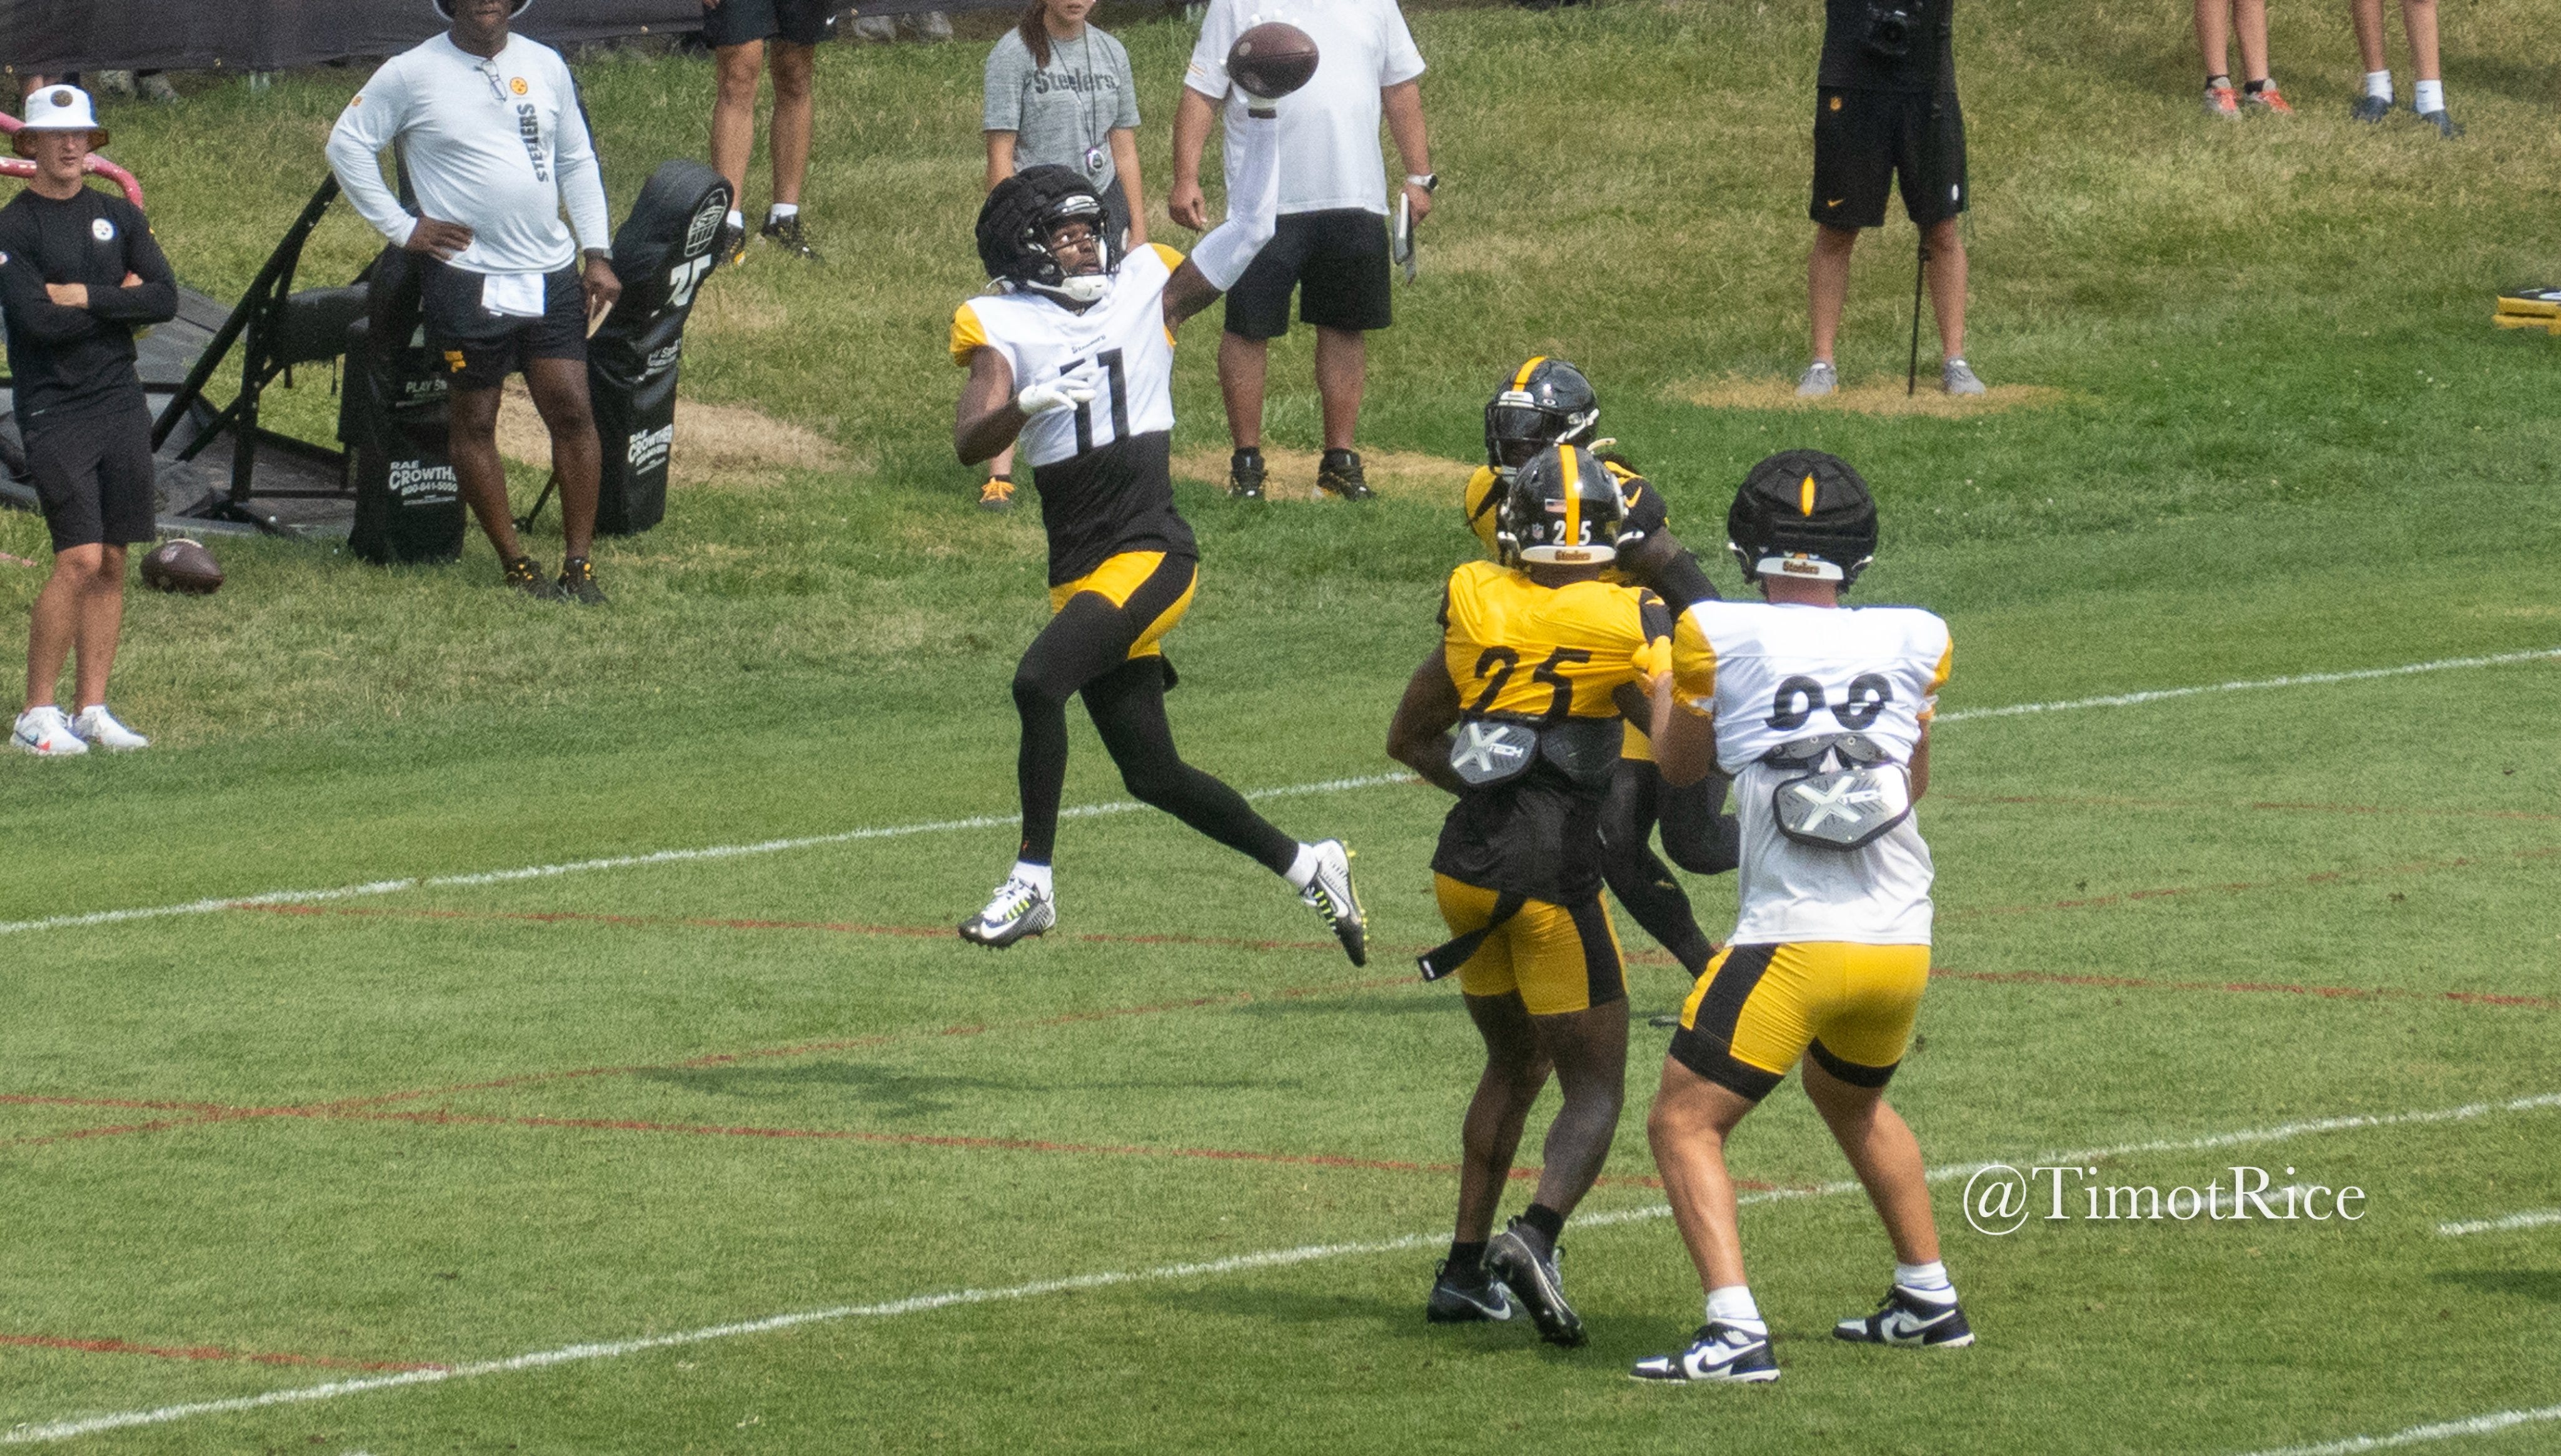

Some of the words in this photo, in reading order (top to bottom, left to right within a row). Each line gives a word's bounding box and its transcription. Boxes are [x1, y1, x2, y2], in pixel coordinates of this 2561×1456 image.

[1034, 68, 1117, 94] Steelers
[516, 103, 549, 182] STEELERS
[389, 466, 458, 490] CROWTH
[390, 460, 420, 470] RAE
[1552, 520, 1592, 546] 25
[1466, 645, 1593, 719] 25
